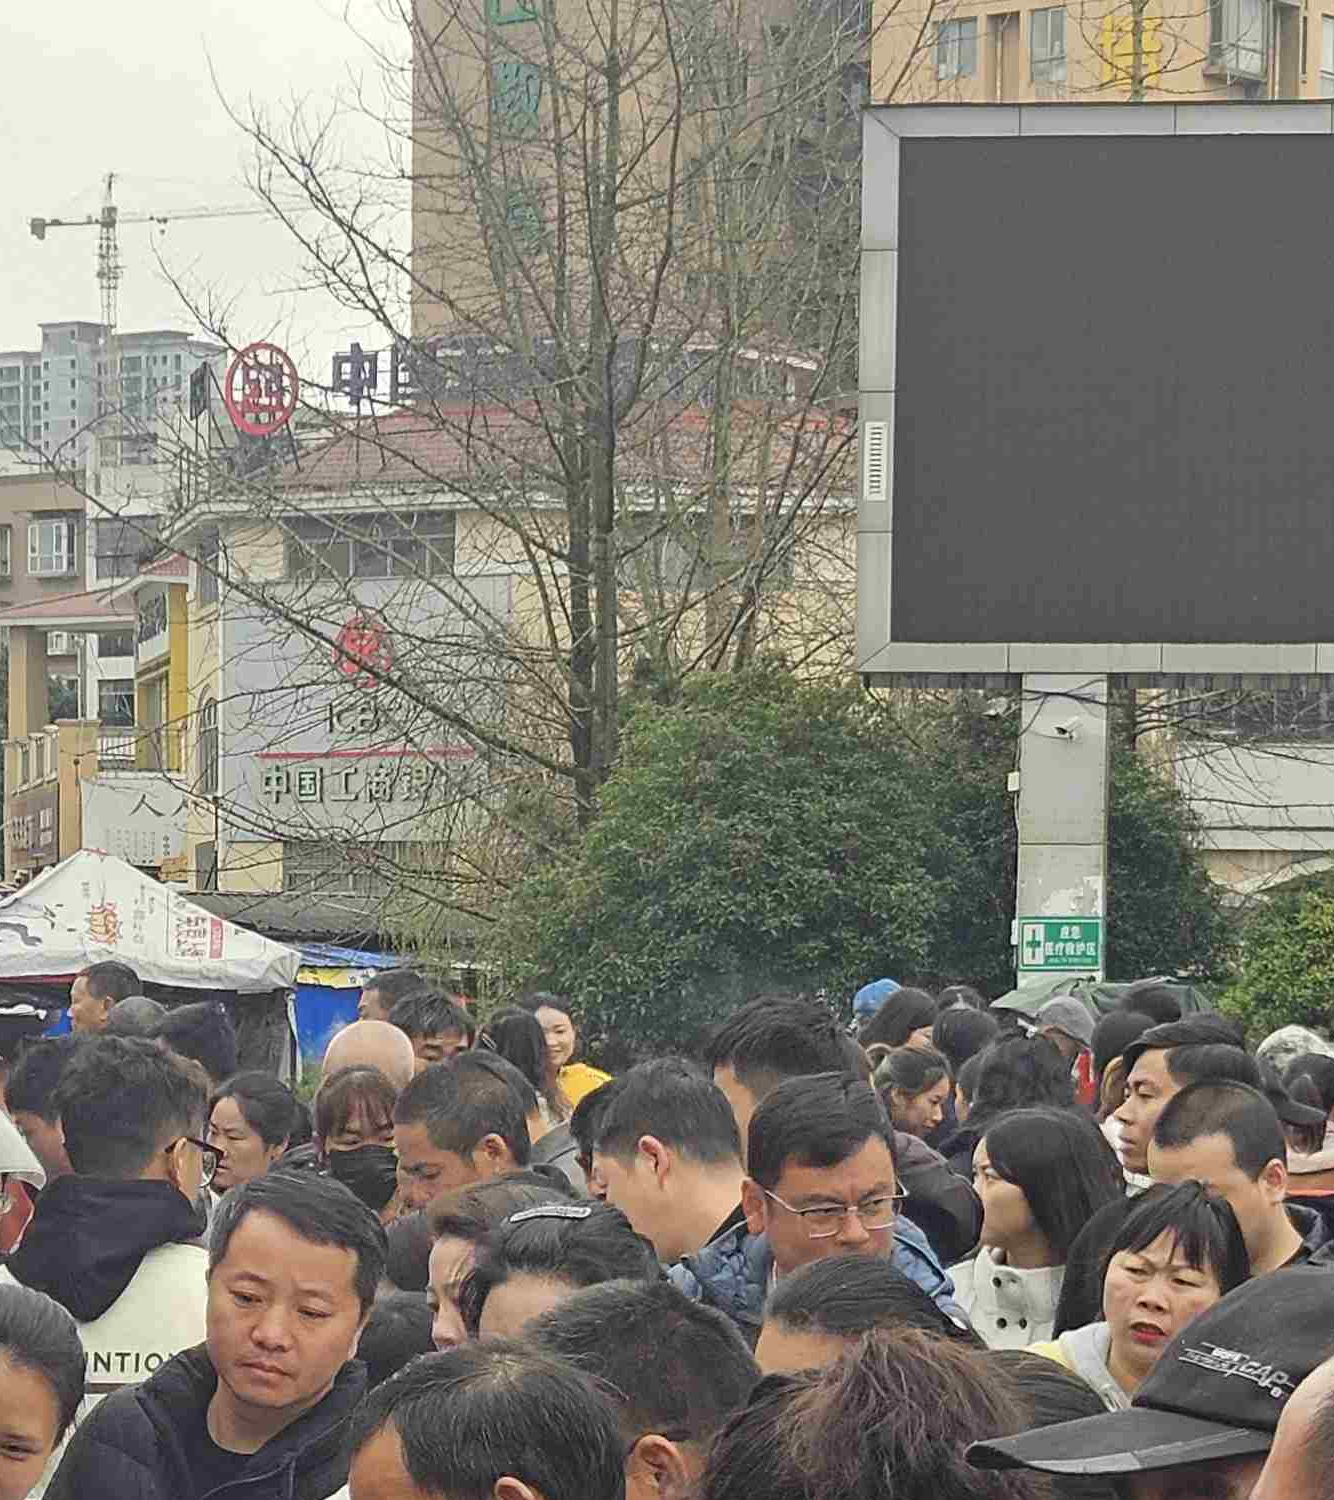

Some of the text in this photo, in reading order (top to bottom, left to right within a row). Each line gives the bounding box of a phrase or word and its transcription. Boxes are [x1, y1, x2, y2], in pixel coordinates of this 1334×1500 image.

[263, 765, 469, 803] 中国工商银
[85, 1351, 173, 1373] NTIO
